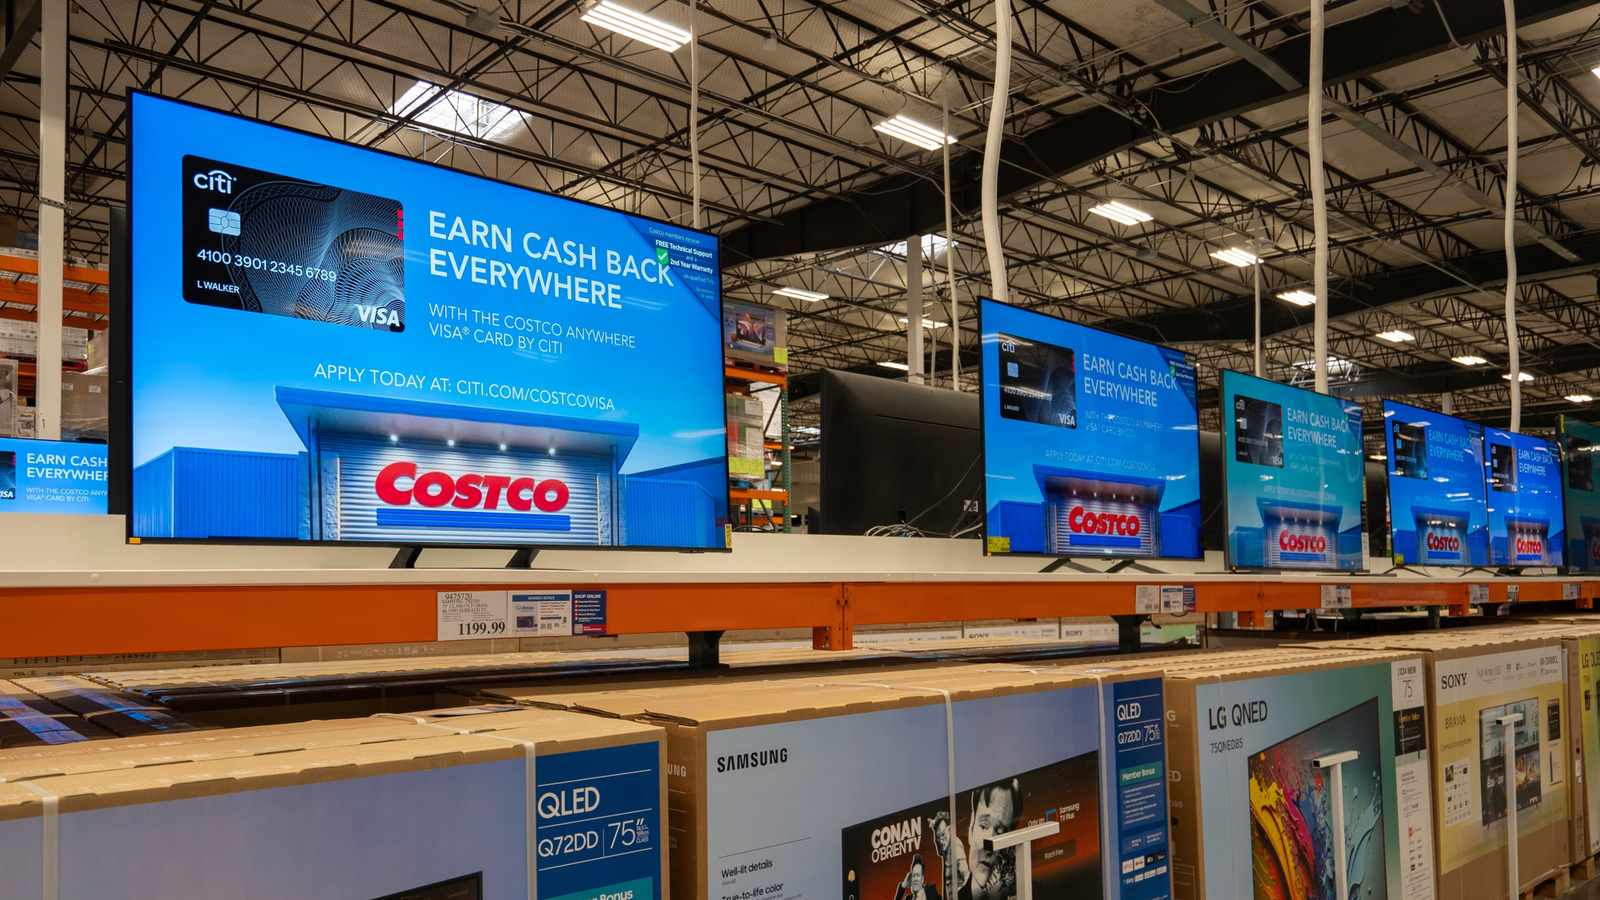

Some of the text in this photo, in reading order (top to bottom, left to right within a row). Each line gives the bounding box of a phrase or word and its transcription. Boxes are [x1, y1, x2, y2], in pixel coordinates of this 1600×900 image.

[193, 170, 232, 194] citi
[649, 227, 664, 236] Costco
[429, 210, 674, 287] EARN CASH BACK
[656, 240, 713, 258] FREE Technical Support
[197, 249, 337, 282] 4100 3901 2345 6789
[670, 258, 713, 274] 2nd Year Warranty
[197, 280, 240, 294] L WALKER
[429, 248, 622, 309] EVERYWHERE
[354, 304, 400, 327] VISA
[429, 303, 636, 348] WITH THE COSTCO ANYWHERE
[474, 330, 514, 348] CARD
[518, 336, 534, 351] BY
[538, 340, 563, 355] CITI
[1001, 340, 1016, 354] citi
[1083, 354, 1178, 390] EARN CASH BACK
[314, 363, 616, 412] APPLY TODAY AT: CITI.COM/COSTCOVISA
[1084, 377, 1158, 407] EVERYWHERE
[1058, 414, 1075, 426] VISA
[1114, 415, 1136, 427] COSTCO
[1136, 420, 1163, 432] ANYWHERE
[1287, 408, 1350, 434] EARN CASH BACK
[1102, 424, 1116, 436] CARD
[1288, 426, 1336, 448] EVERYWHERE
[1428, 430, 1444, 443] EARN
[1444, 432, 1458, 447] CASH
[27, 453, 108, 468] EARN CASH
[1046, 450, 1064, 460] APPLY
[1065, 452, 1085, 462] TODAY
[1430, 445, 1464, 462] EVERYWHERE
[1518, 449, 1530, 460] EARN
[1519, 463, 1546, 476] EVERYWHERE
[375, 461, 570, 513] COSTCO
[1068, 506, 1140, 536] COSTCO
[1279, 530, 1326, 552] COSTCO
[1427, 532, 1460, 551] COSTCO
[1516, 537, 1542, 553] COSTCO
[458, 622, 505, 636] 1199.99
[1582, 653, 1589, 669] LG
[1441, 673, 1467, 690] SONY
[1117, 702, 1141, 721] QLED
[1208, 700, 1268, 730] LG QNED
[1445, 714, 1466, 730] BRAVIA
[1118, 730, 1141, 744] Q72DD
[1210, 738, 1243, 754] 75QNED85
[717, 748, 788, 773] SAMSUNG
[1122, 768, 1155, 781] Member Bonus
[538, 786, 600, 819] QLED
[1059, 803, 1080, 814] Samsung
[1060, 814, 1065, 822] TV
[871, 816, 921, 849] CONAN
[538, 830, 599, 857] Q72DD
[1044, 851, 1055, 859] Watch
[722, 860, 773, 878] Well-lit details
[765, 884, 784, 894] color
